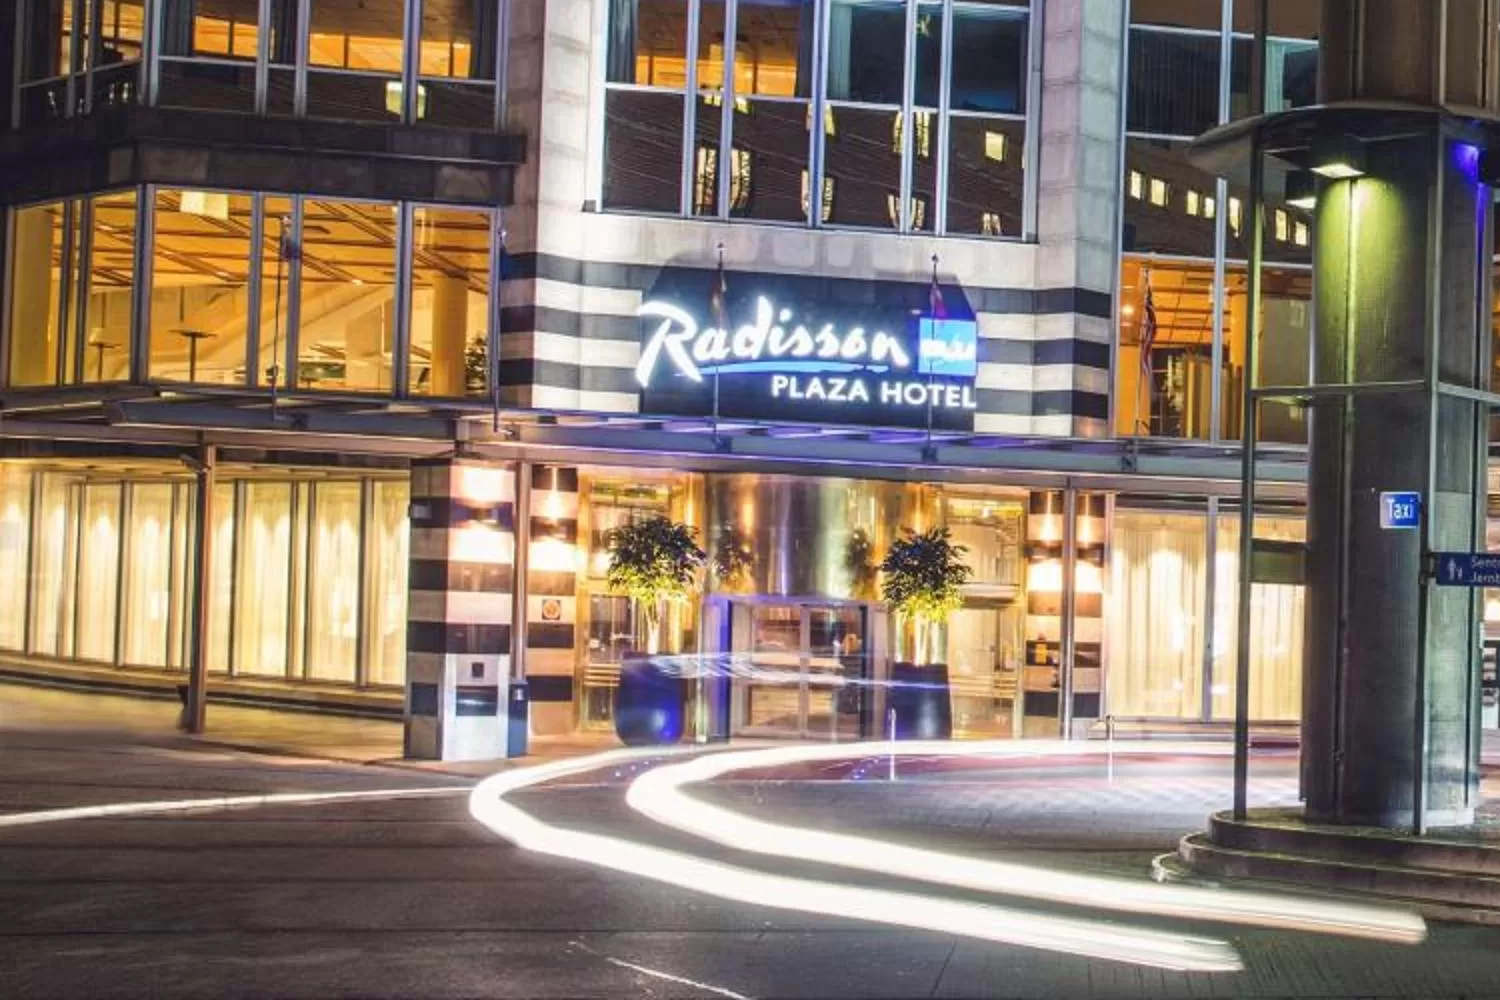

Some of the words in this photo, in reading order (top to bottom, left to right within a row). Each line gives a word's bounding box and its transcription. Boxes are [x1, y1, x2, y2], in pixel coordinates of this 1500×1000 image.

[635, 296, 909, 387] Radisson
[771, 375, 868, 401] PLAZA
[881, 381, 976, 409] HOTEL
[1386, 498, 1414, 519] Taxi
